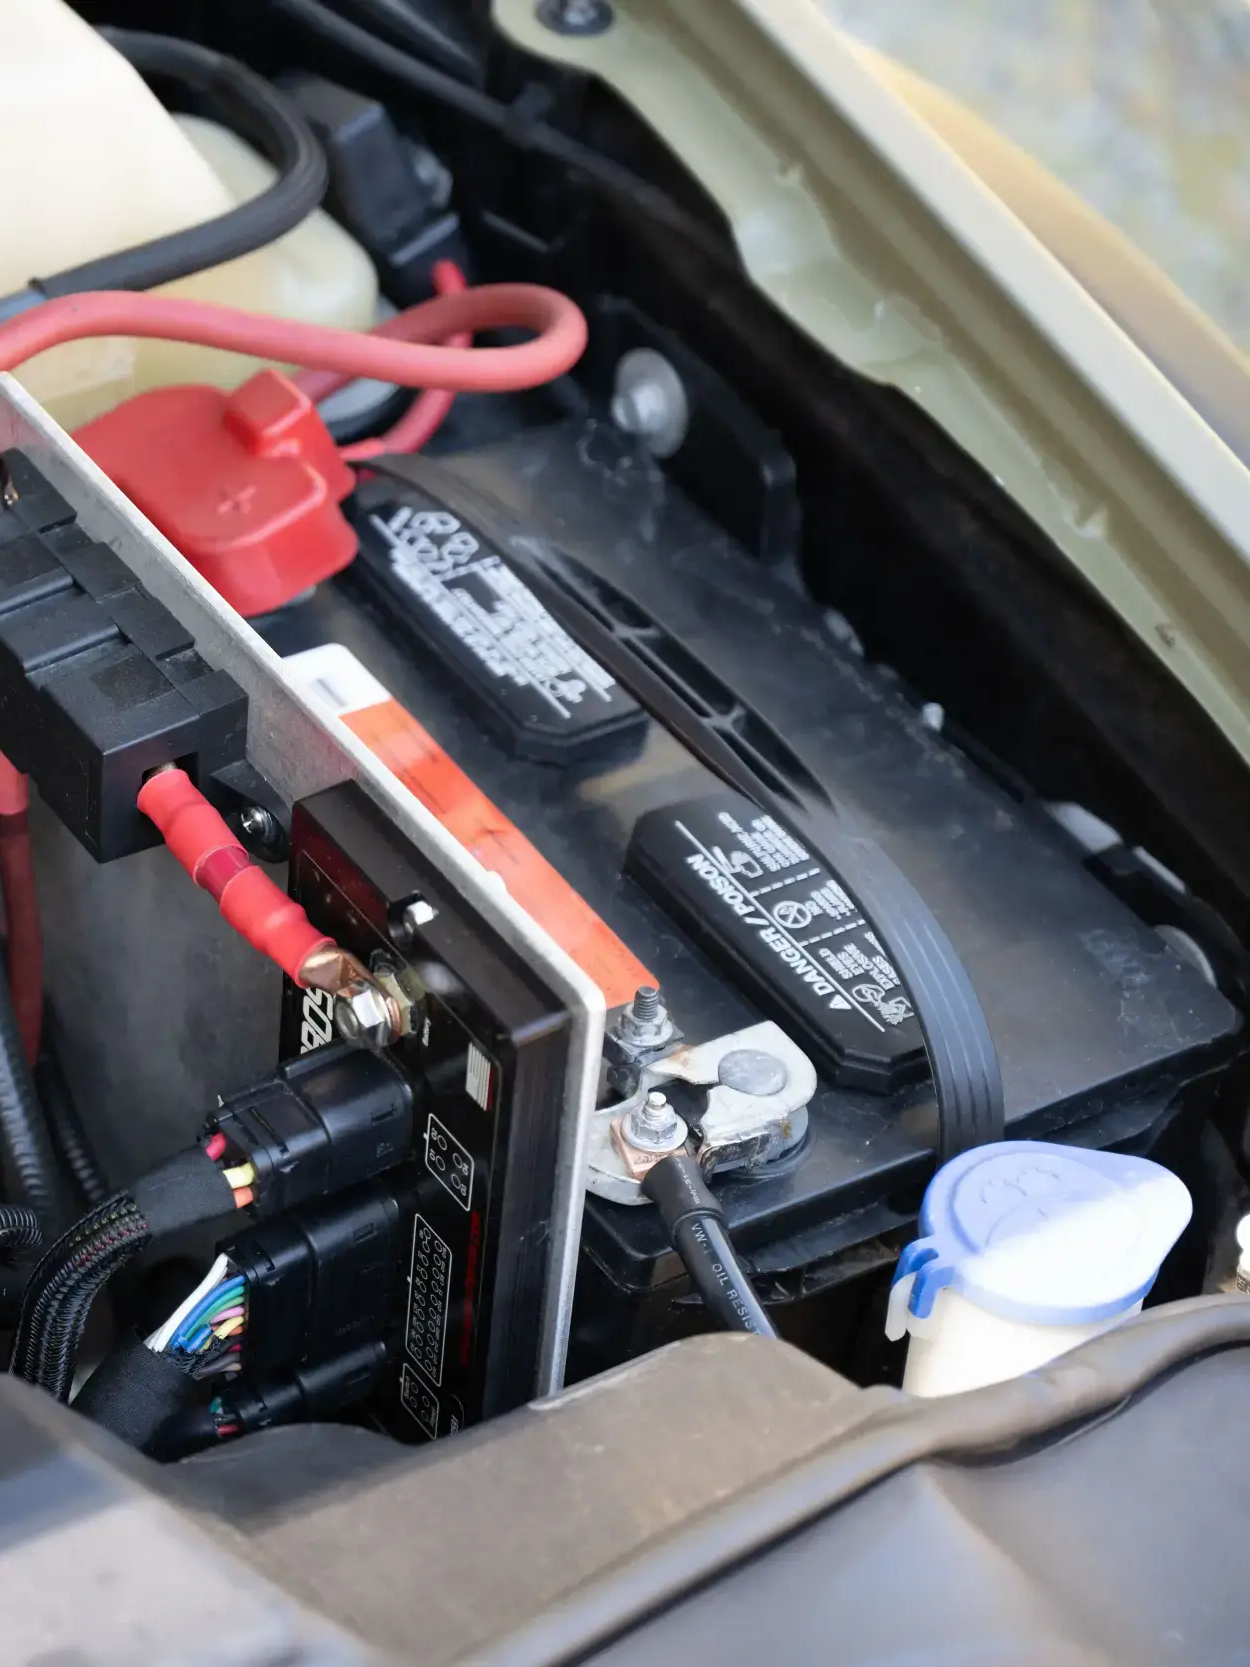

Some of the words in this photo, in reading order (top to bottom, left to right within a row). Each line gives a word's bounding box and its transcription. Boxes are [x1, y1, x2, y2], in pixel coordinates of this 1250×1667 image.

[686, 853, 756, 918] POISON
[759, 928, 834, 997] DANGER
[818, 947, 853, 980] SHIELD
[837, 951, 865, 976] EYES
[843, 942, 895, 991] EXPLOSIVE
[712, 1263, 730, 1286] OIL
